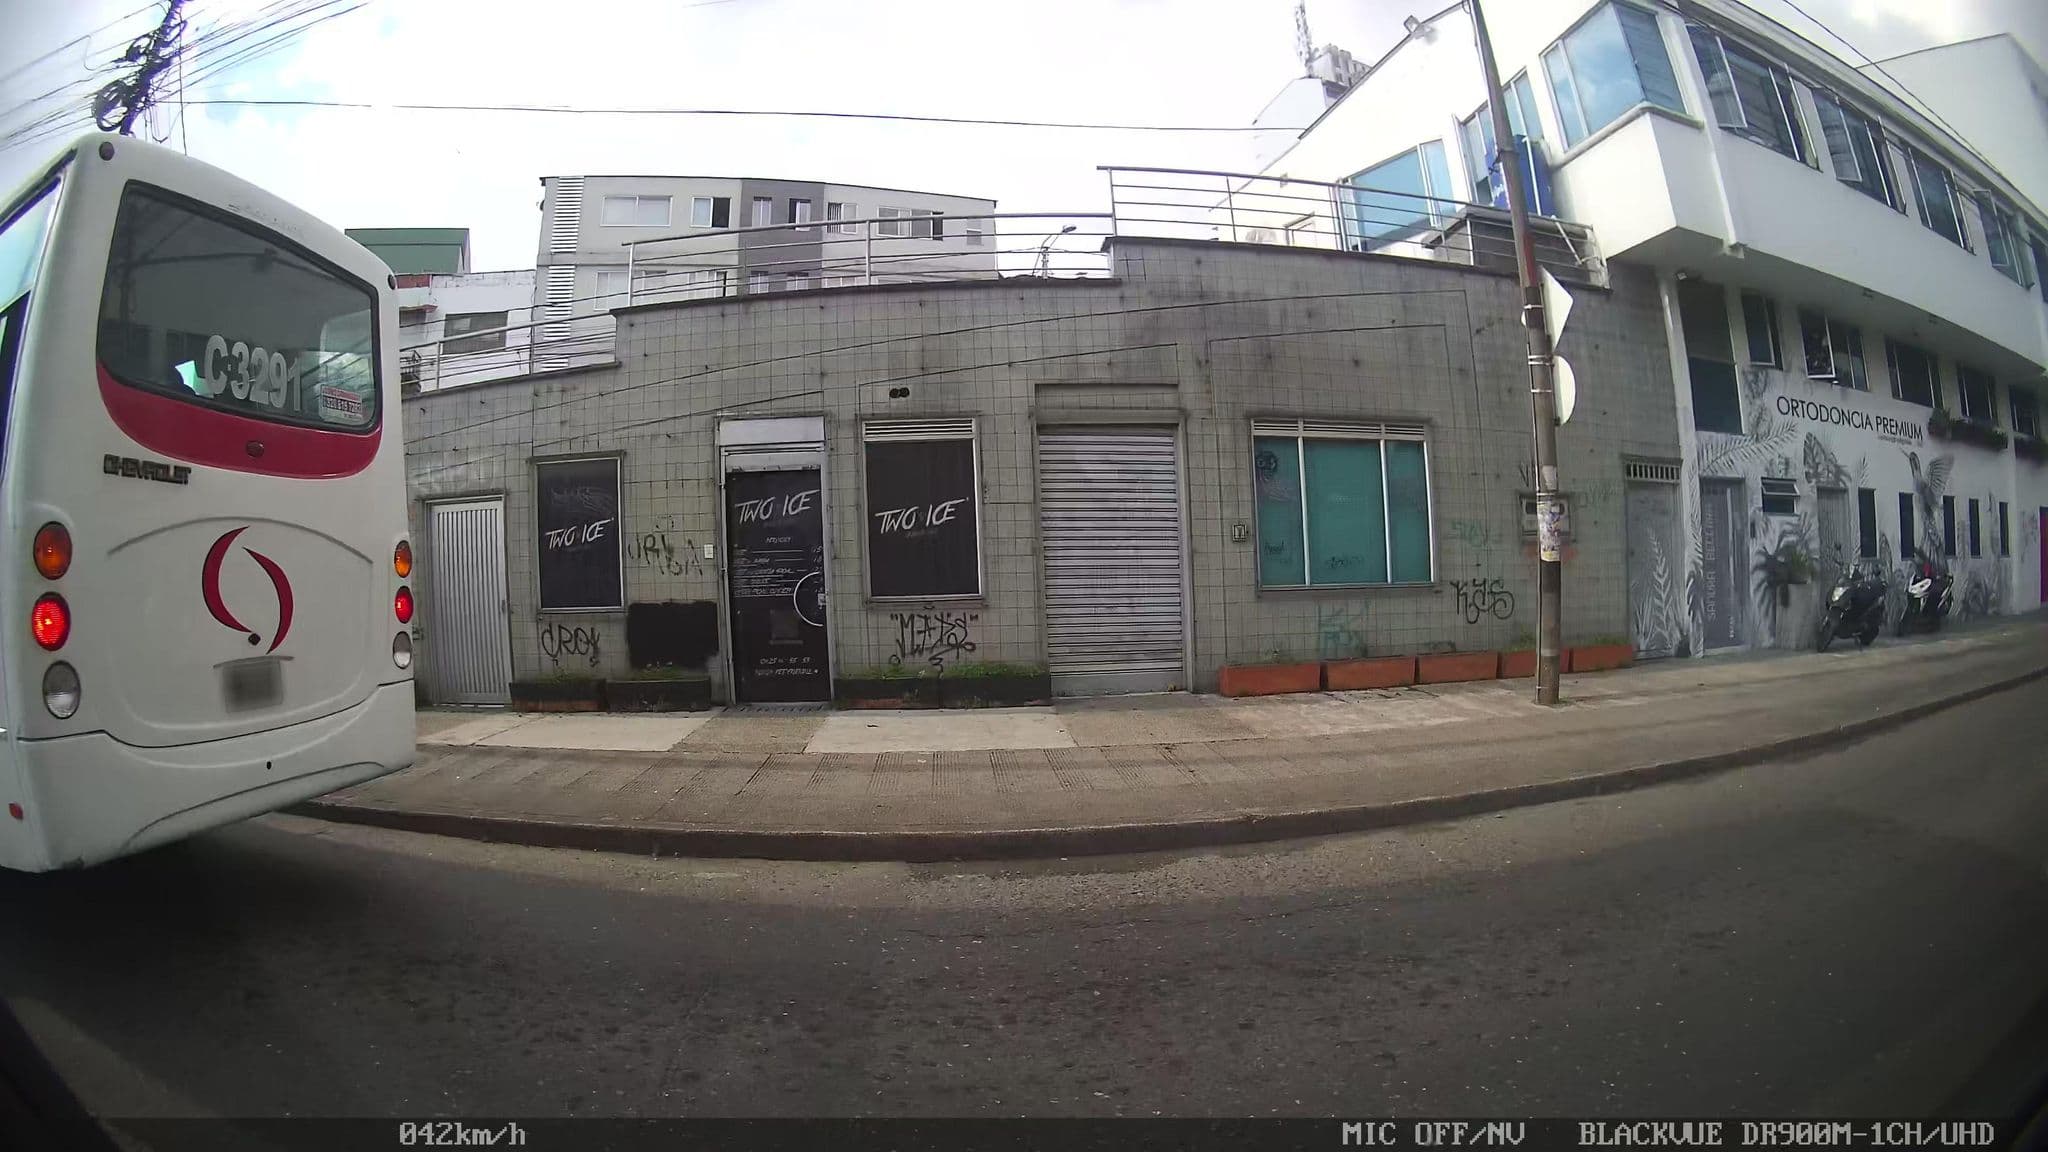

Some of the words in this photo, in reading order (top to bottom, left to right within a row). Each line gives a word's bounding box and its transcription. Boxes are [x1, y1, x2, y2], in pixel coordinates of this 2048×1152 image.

[1776, 395, 1874, 431] ORTODONCIA
[1875, 415, 1924, 442] PREMIUM
[103, 453, 192, 485] CHEVROLET
[734, 496, 776, 525] TWO
[781, 489, 820, 517] ICE
[875, 506, 915, 535] TWO
[925, 498, 968, 526] ICE
[544, 525, 578, 550] TWO
[581, 518, 612, 545] ICE
